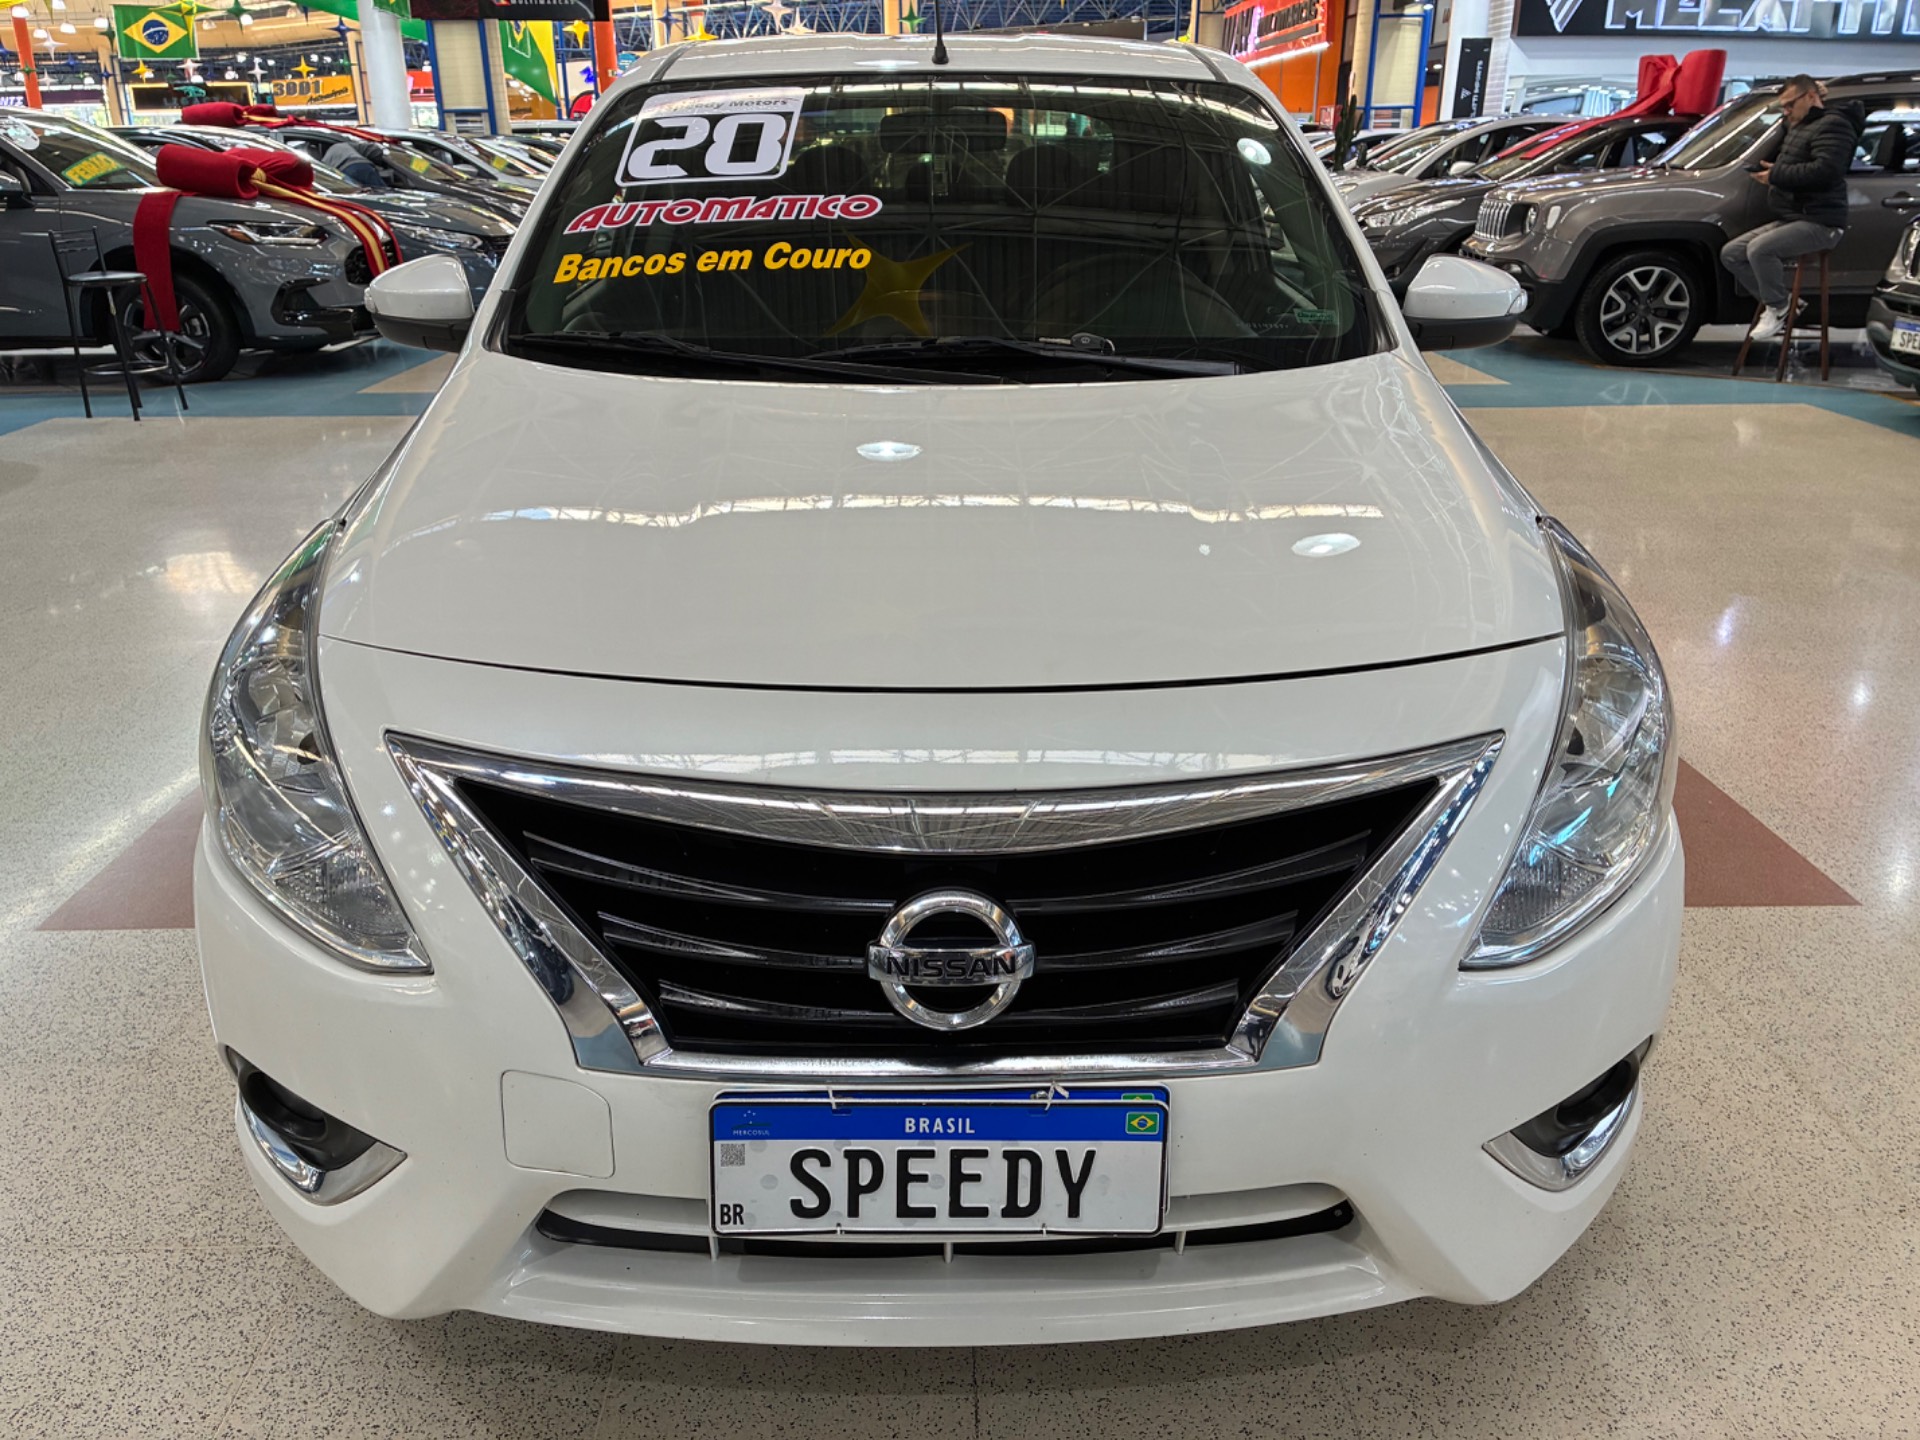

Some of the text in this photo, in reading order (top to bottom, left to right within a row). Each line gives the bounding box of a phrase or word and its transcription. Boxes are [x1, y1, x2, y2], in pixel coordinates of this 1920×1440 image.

[272, 79, 322, 97] 3001
[729, 99, 788, 108] Motors
[626, 113, 787, 178] 20
[565, 195, 883, 234] AUTOMATICO
[553, 241, 872, 284] Bancos em Couro
[1899, 331, 1920, 351] SPE
[886, 952, 1017, 980] NISSAN
[732, 1129, 770, 1137] MERCOSUL
[905, 1117, 976, 1135] BRASIL
[789, 1149, 1097, 1220] SPEEDY
[720, 1203, 745, 1226] BR
